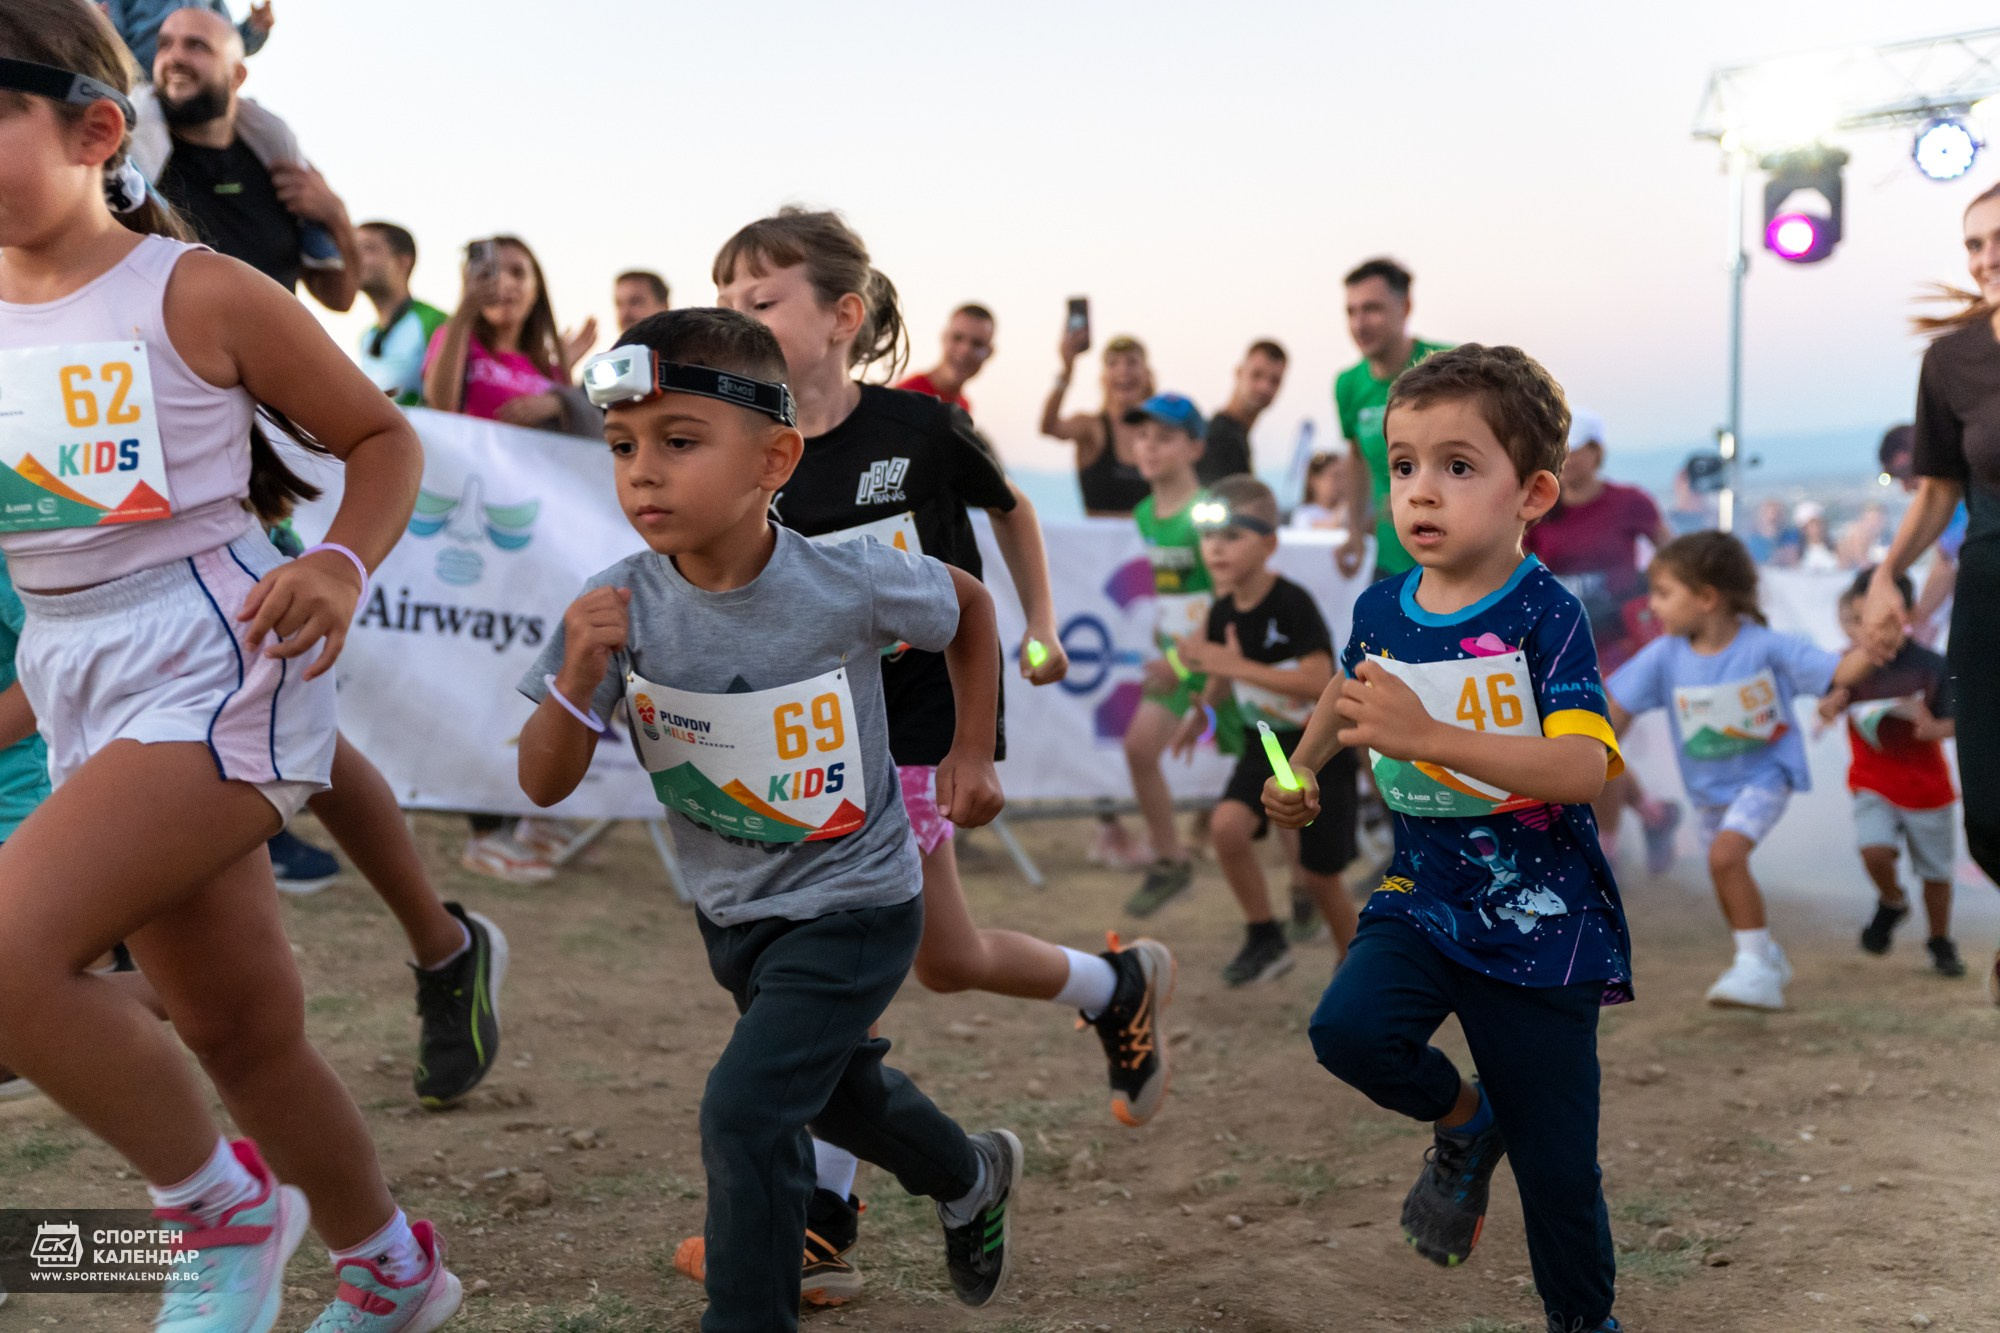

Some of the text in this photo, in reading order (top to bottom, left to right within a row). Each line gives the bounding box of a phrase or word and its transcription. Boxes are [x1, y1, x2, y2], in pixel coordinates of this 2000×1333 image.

[59, 361, 141, 428] 62
[59, 438, 140, 477] KIDS
[357, 584, 545, 652] Airways
[660, 710, 711, 733] PLOVDIV
[773, 691, 845, 761] 69
[1456, 672, 1524, 731] 46
[663, 724, 696, 744] HILLS
[768, 762, 845, 802] KIDS
